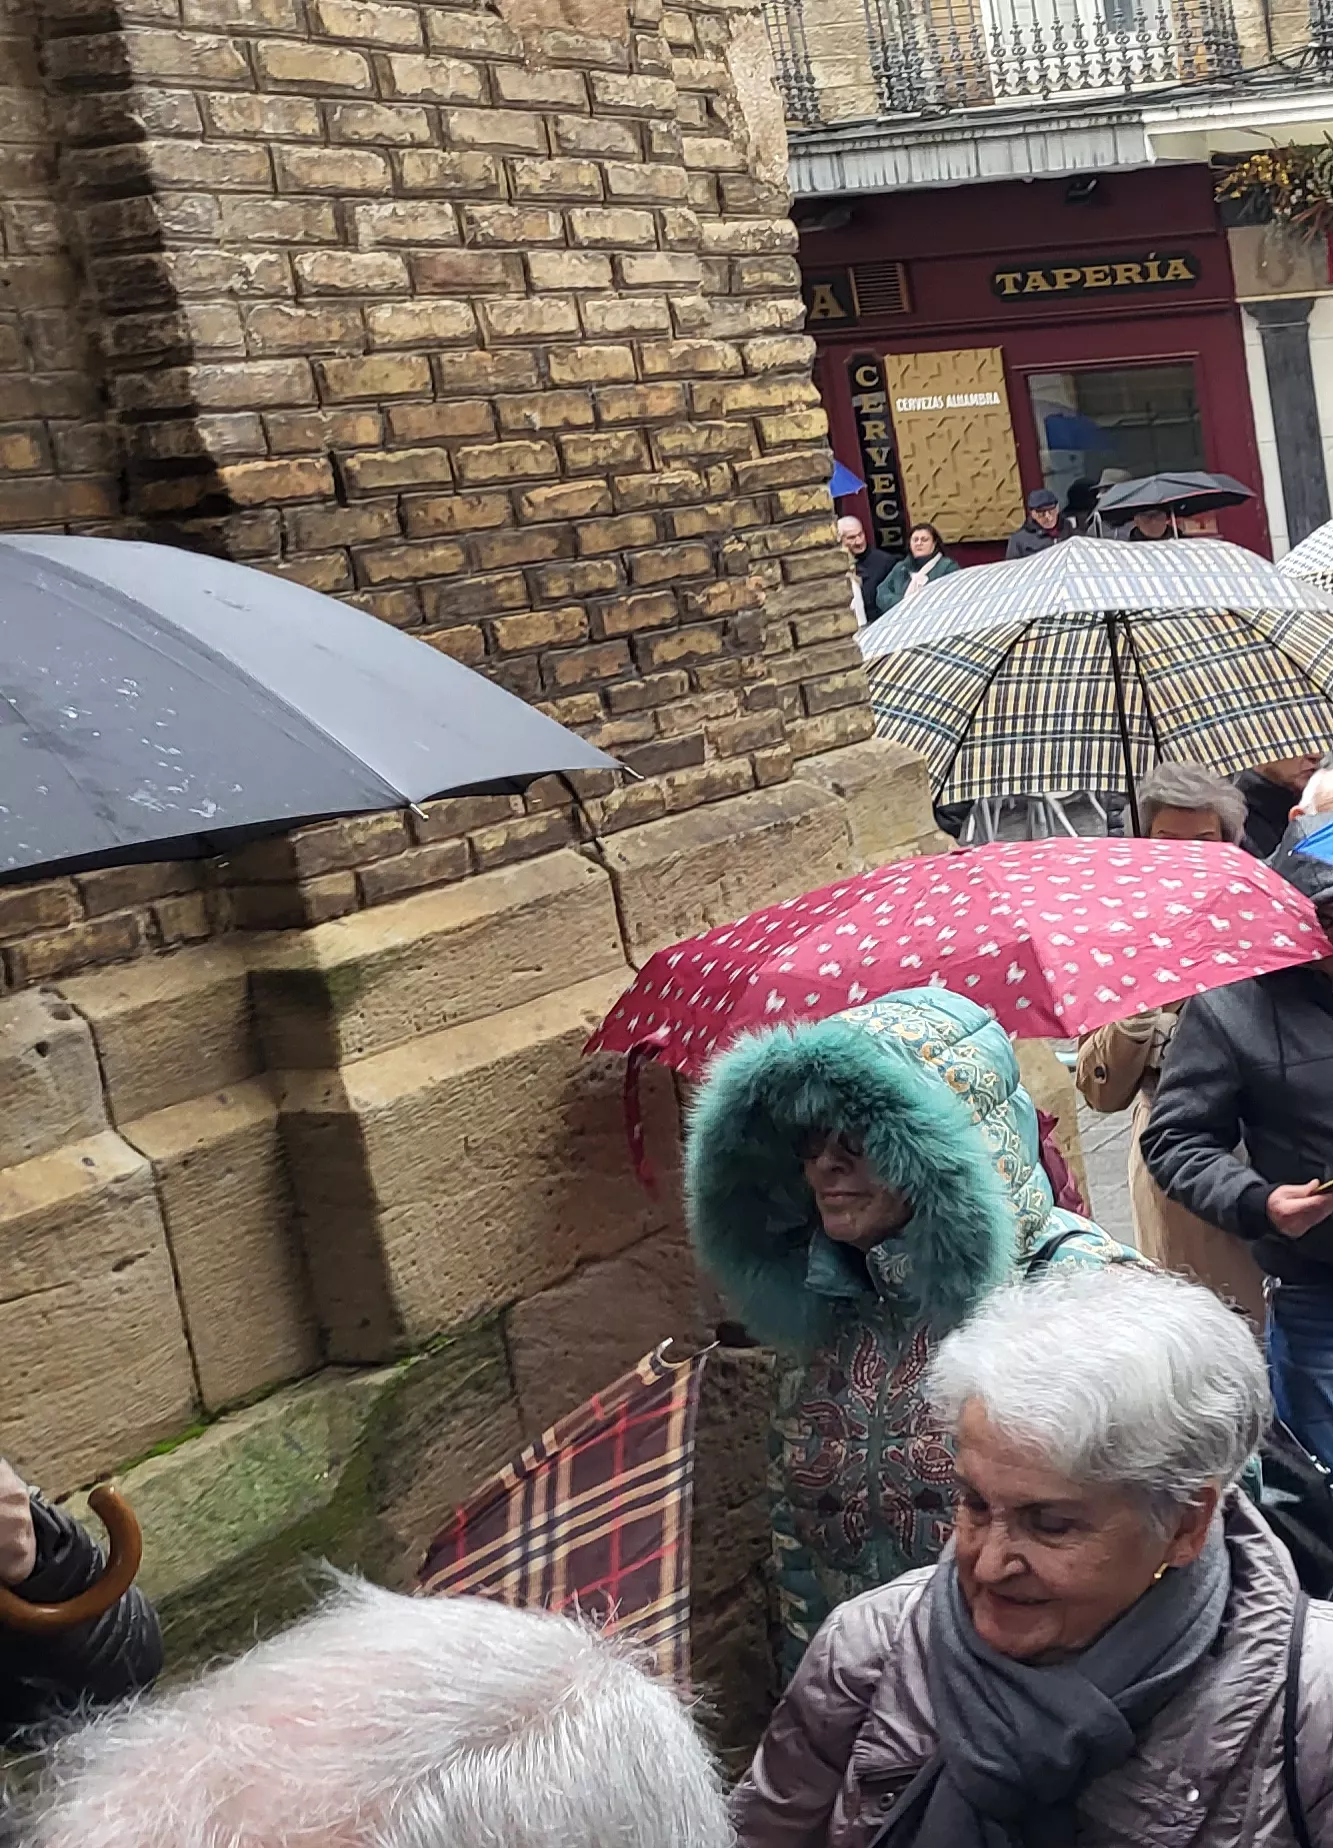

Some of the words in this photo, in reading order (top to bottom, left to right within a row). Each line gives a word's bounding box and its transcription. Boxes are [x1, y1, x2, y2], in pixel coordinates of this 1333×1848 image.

[995, 252, 1195, 296] TAPERÍA
[896, 395, 945, 412] CERVEZAS
[946, 391, 1001, 409] ALHAMBRA
